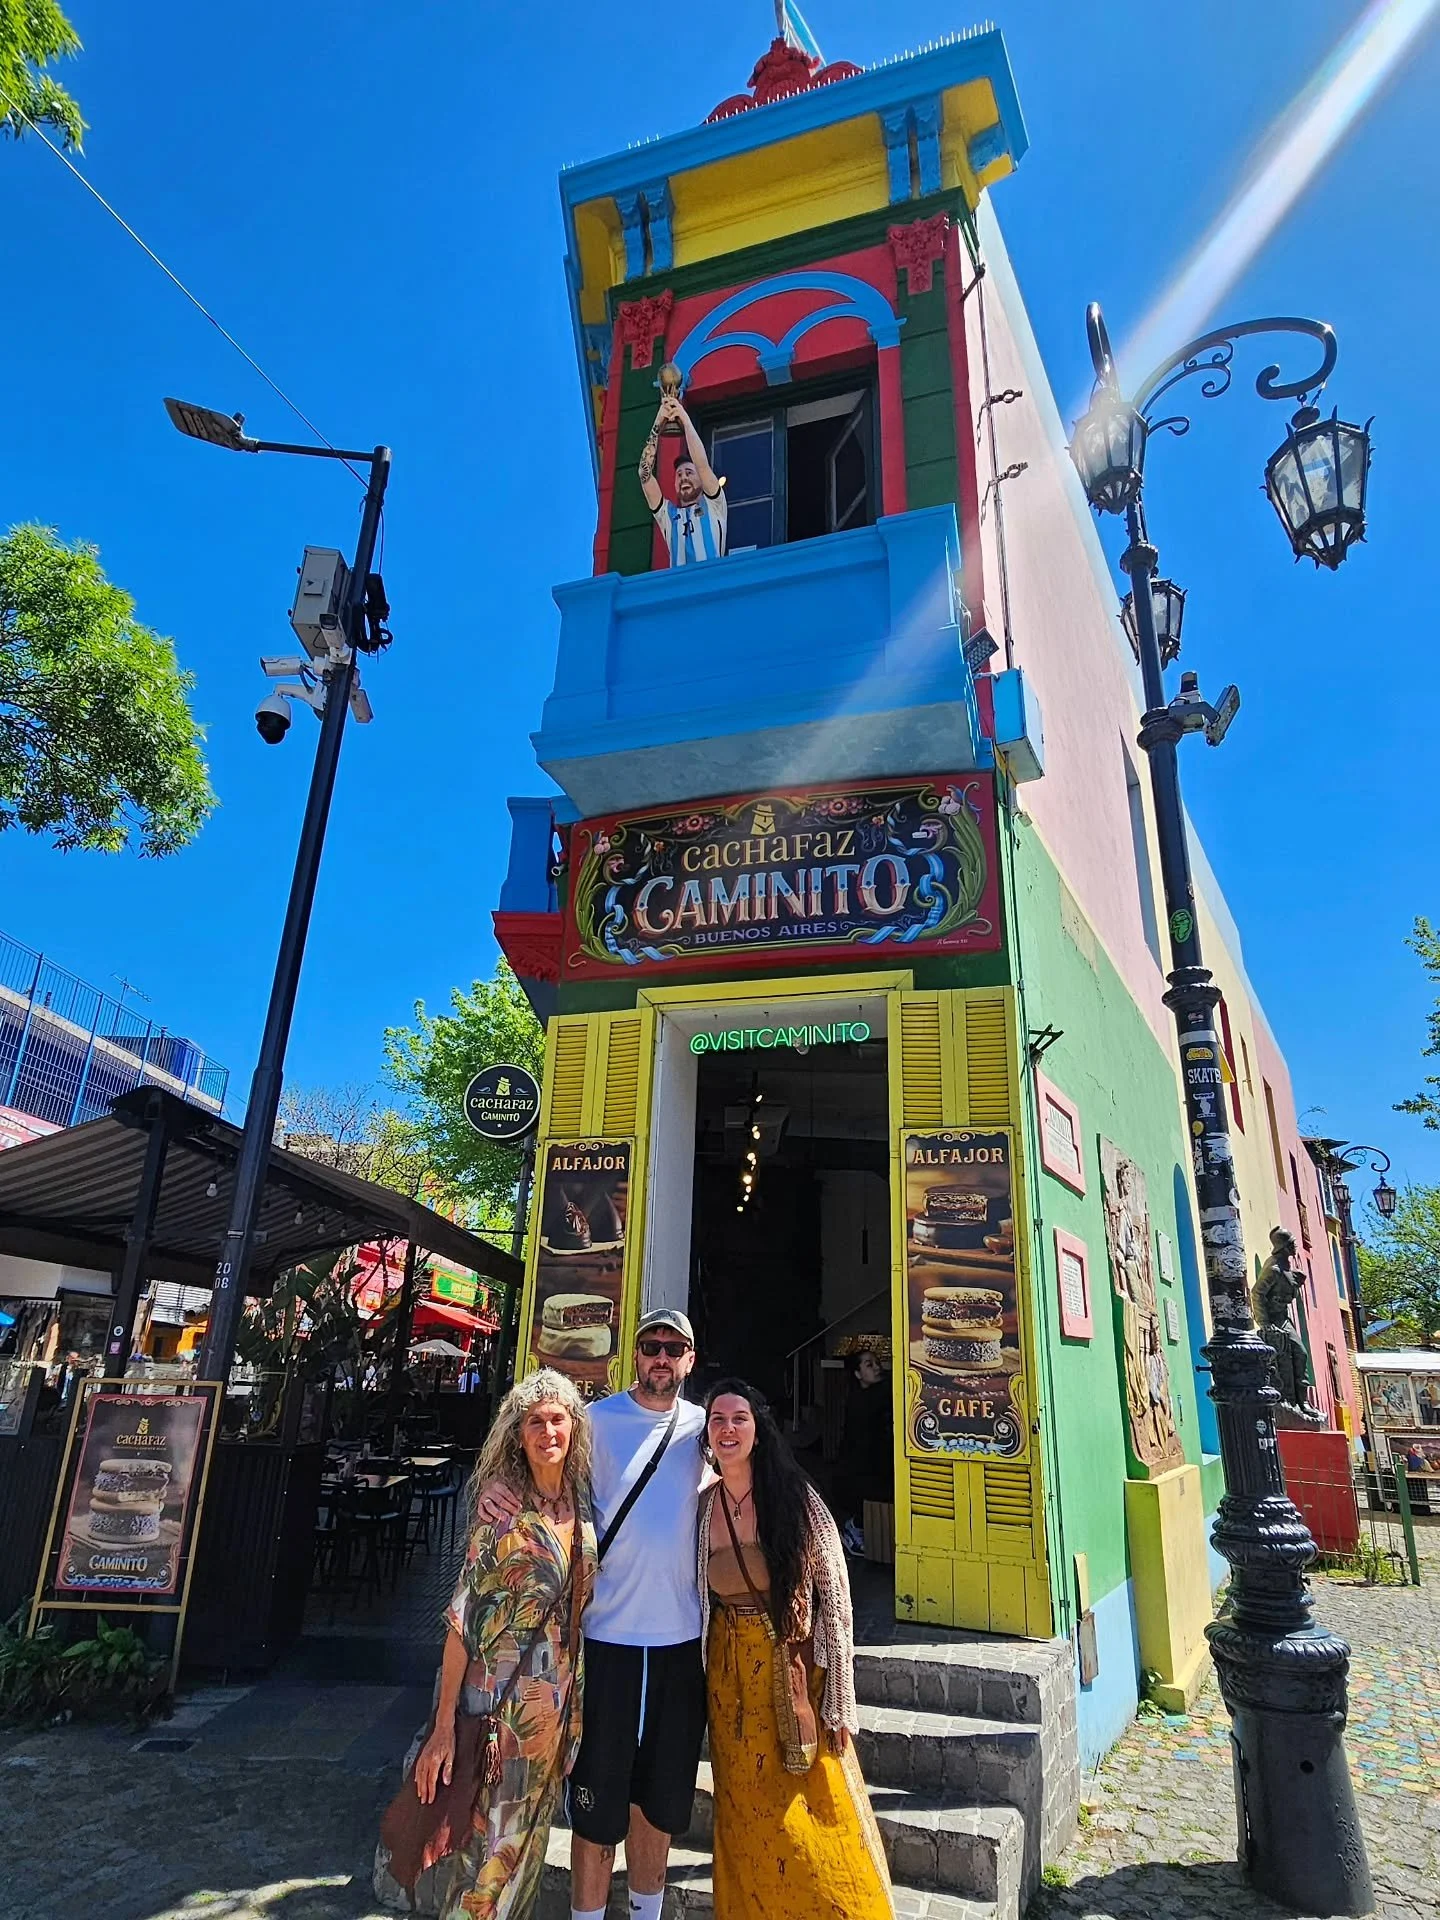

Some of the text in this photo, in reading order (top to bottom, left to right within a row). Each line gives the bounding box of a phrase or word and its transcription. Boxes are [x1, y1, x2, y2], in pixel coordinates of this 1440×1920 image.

[632, 853, 910, 934] CAMINITO
[695, 921, 838, 944] BUENOS AIRES
[690, 1022, 870, 1054] @VISITCAMINITO
[481, 1111, 520, 1122] CAMINITO
[552, 1156, 625, 1171] ALFAJOR
[913, 1147, 1004, 1165] ALFAJOR
[216, 1262, 231, 1274] 20
[215, 1277, 229, 1289] 08
[938, 1399, 995, 1419] CAFE
[89, 1554, 148, 1572] CAMINITO
